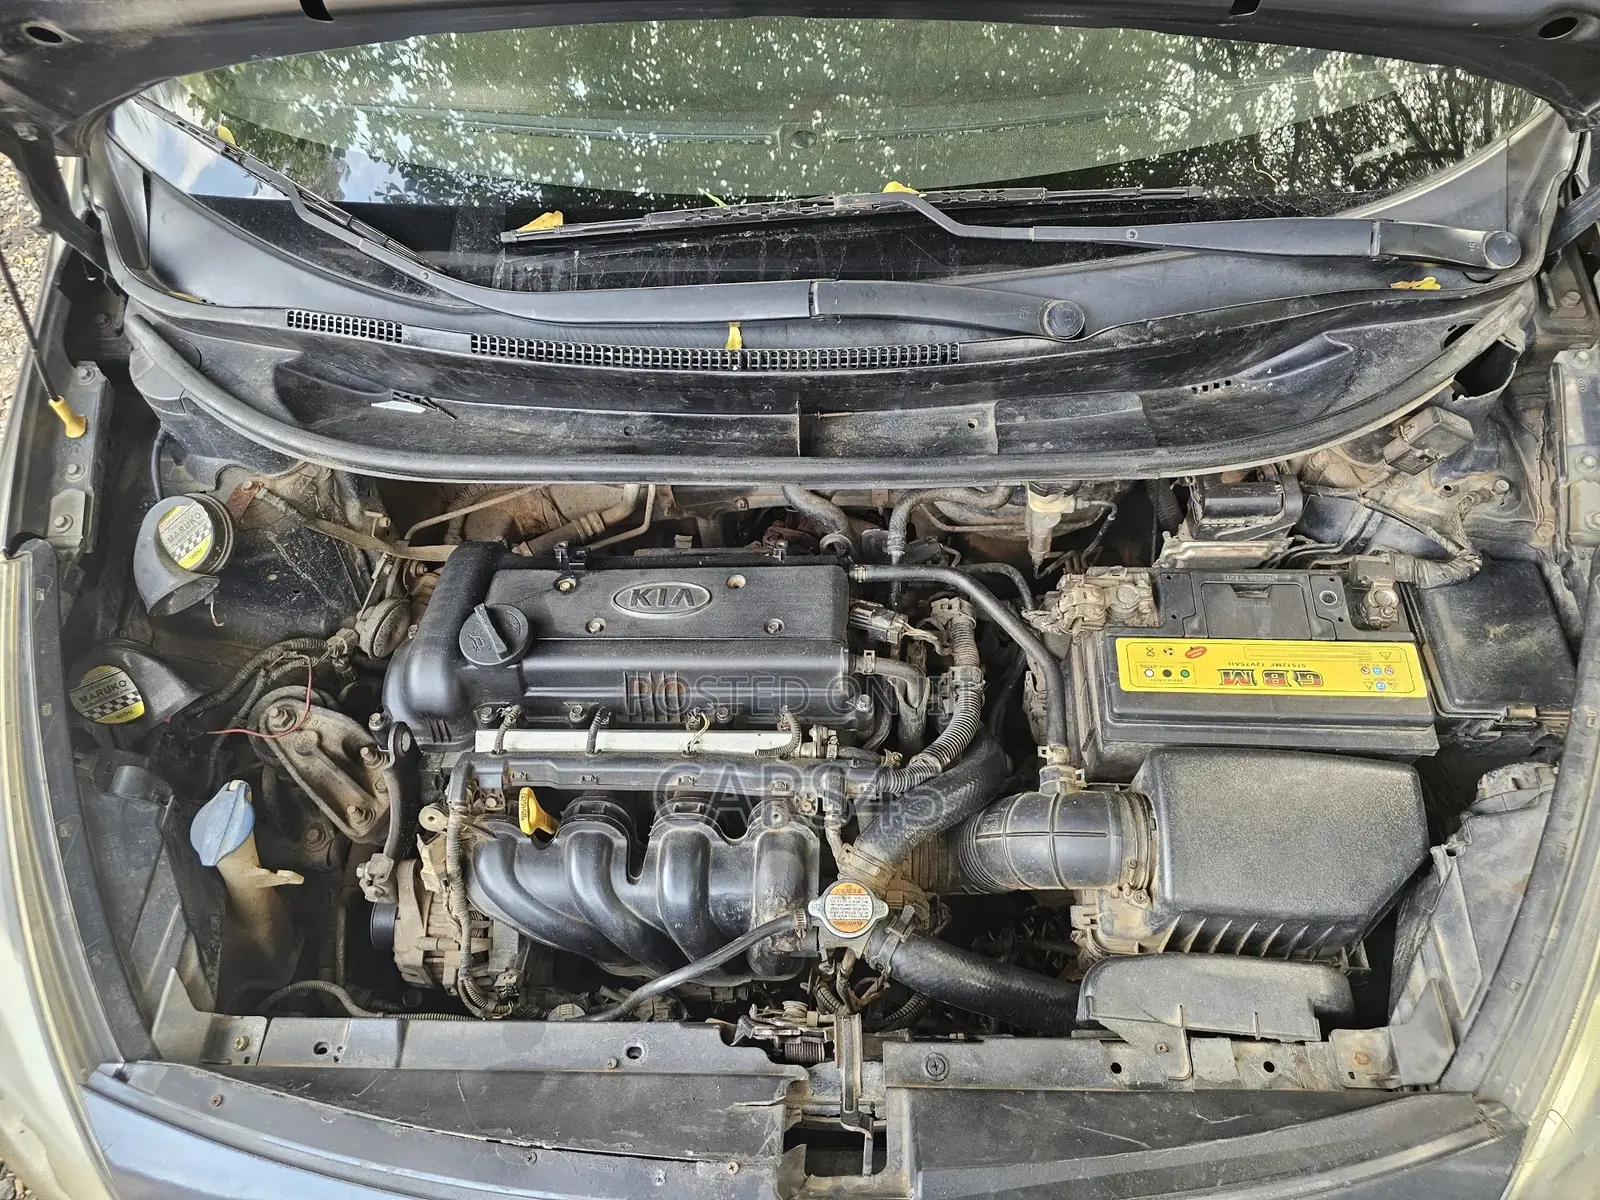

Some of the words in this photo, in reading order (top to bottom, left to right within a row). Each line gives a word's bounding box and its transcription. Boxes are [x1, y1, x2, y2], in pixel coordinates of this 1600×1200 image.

[166, 511, 202, 544] MARUKO
[628, 588, 696, 608] KIA
[78, 679, 128, 704] MARUKO
